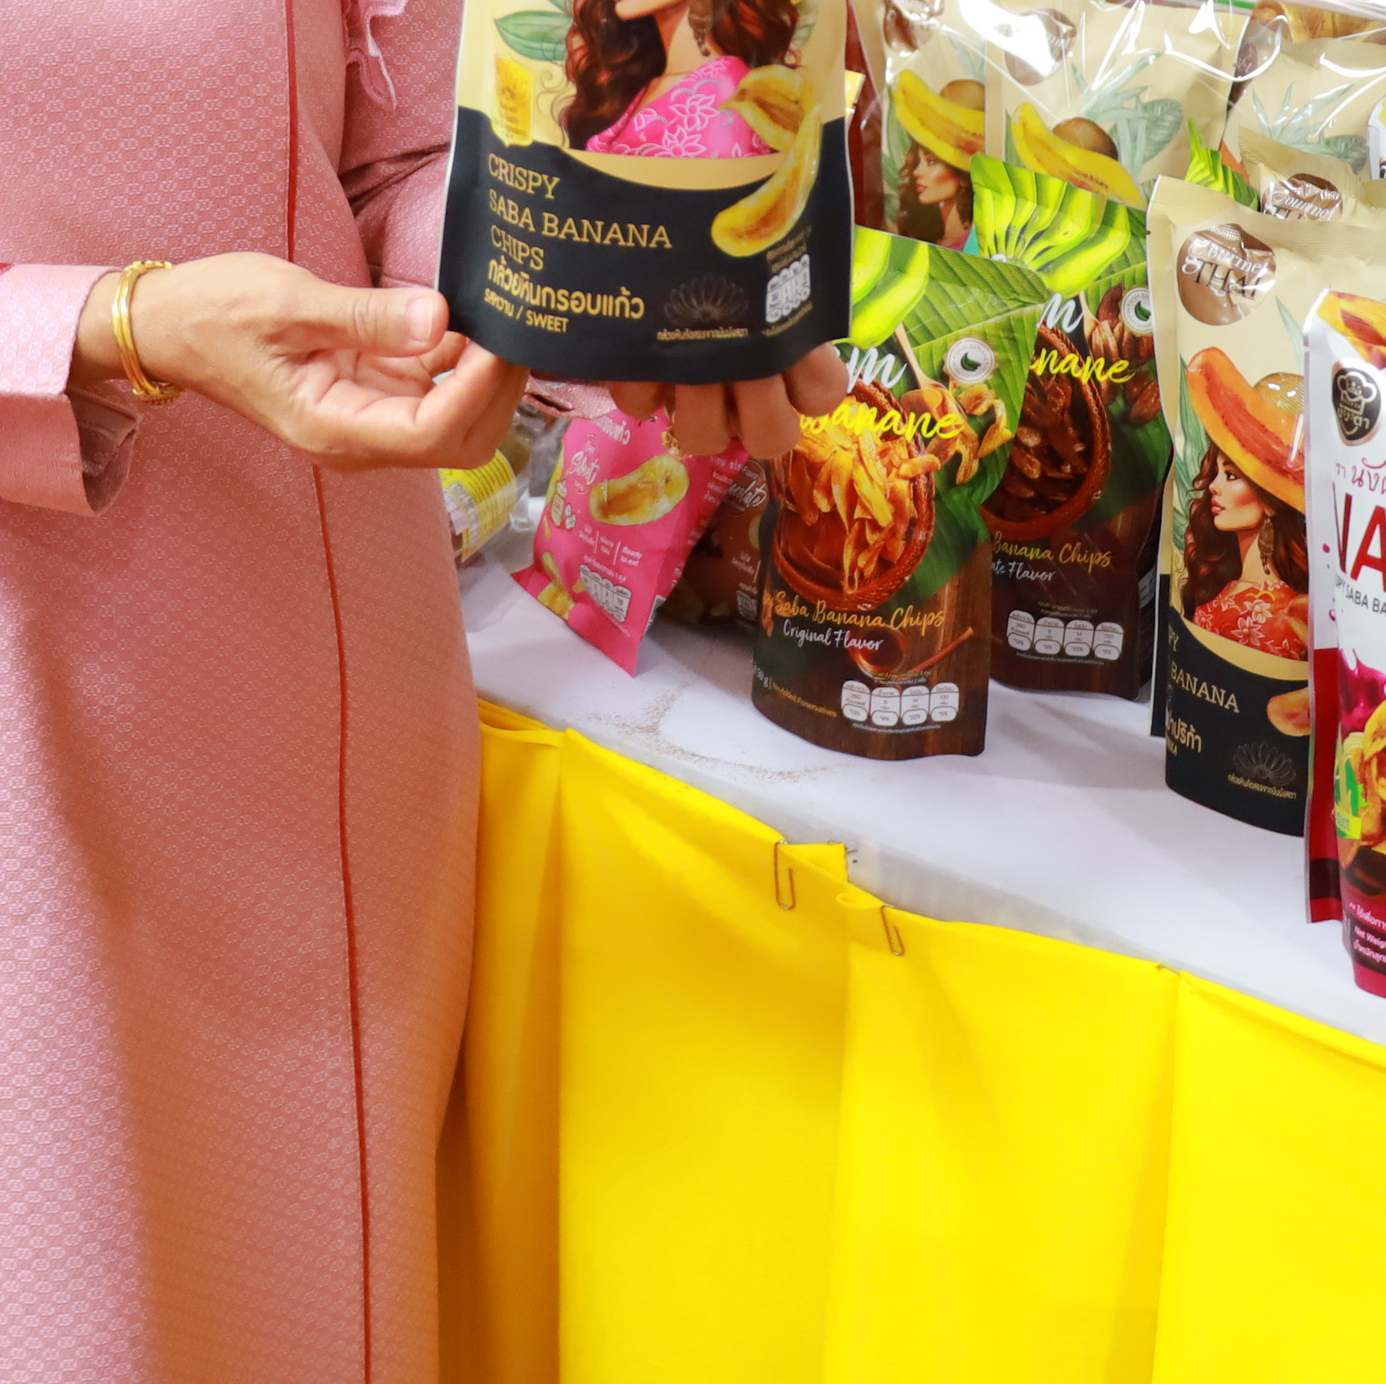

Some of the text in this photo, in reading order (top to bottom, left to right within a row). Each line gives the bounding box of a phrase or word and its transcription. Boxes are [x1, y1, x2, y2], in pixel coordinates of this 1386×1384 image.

[488, 153, 560, 199] CRISPY
[489, 188, 673, 249] SABA BANANA
[490, 225, 545, 272] CHIPS
[484, 288, 514, 318] รสหวาน
[526, 311, 570, 333] SWEET
[488, 256, 645, 320] กล้วยหินกรอบแก้ว
[992, 530, 1113, 573] Banana Chips
[1008, 561, 1056, 581] Flavor
[774, 590, 809, 617] Saba
[813, 599, 886, 627] Banana
[889, 604, 947, 636] Chips
[1345, 583, 1370, 610] SABA
[783, 618, 884, 651] Original Flavor
[1170, 660, 1240, 714] BANANA
